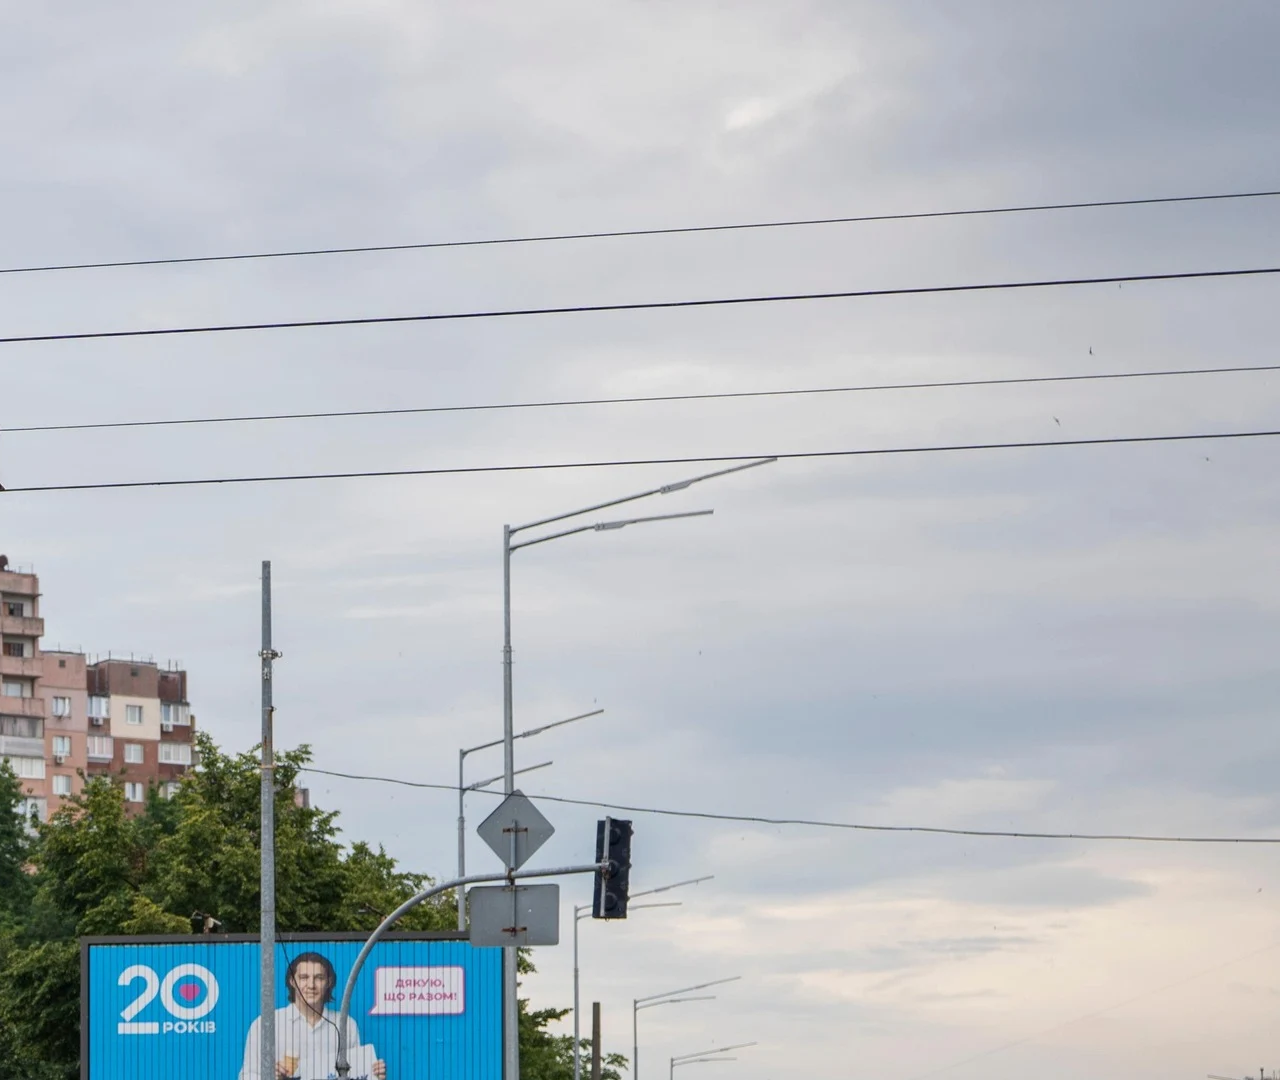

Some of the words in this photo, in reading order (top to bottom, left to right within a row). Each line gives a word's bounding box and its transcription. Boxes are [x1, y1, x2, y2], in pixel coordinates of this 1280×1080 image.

[395, 978, 445, 989] ДЯКУЮ,
[118, 963, 219, 1034] 20
[384, 993, 405, 1002] ЩО
[409, 992, 457, 1001] РАЗОМ!
[163, 1021, 216, 1034] РОКІВ
